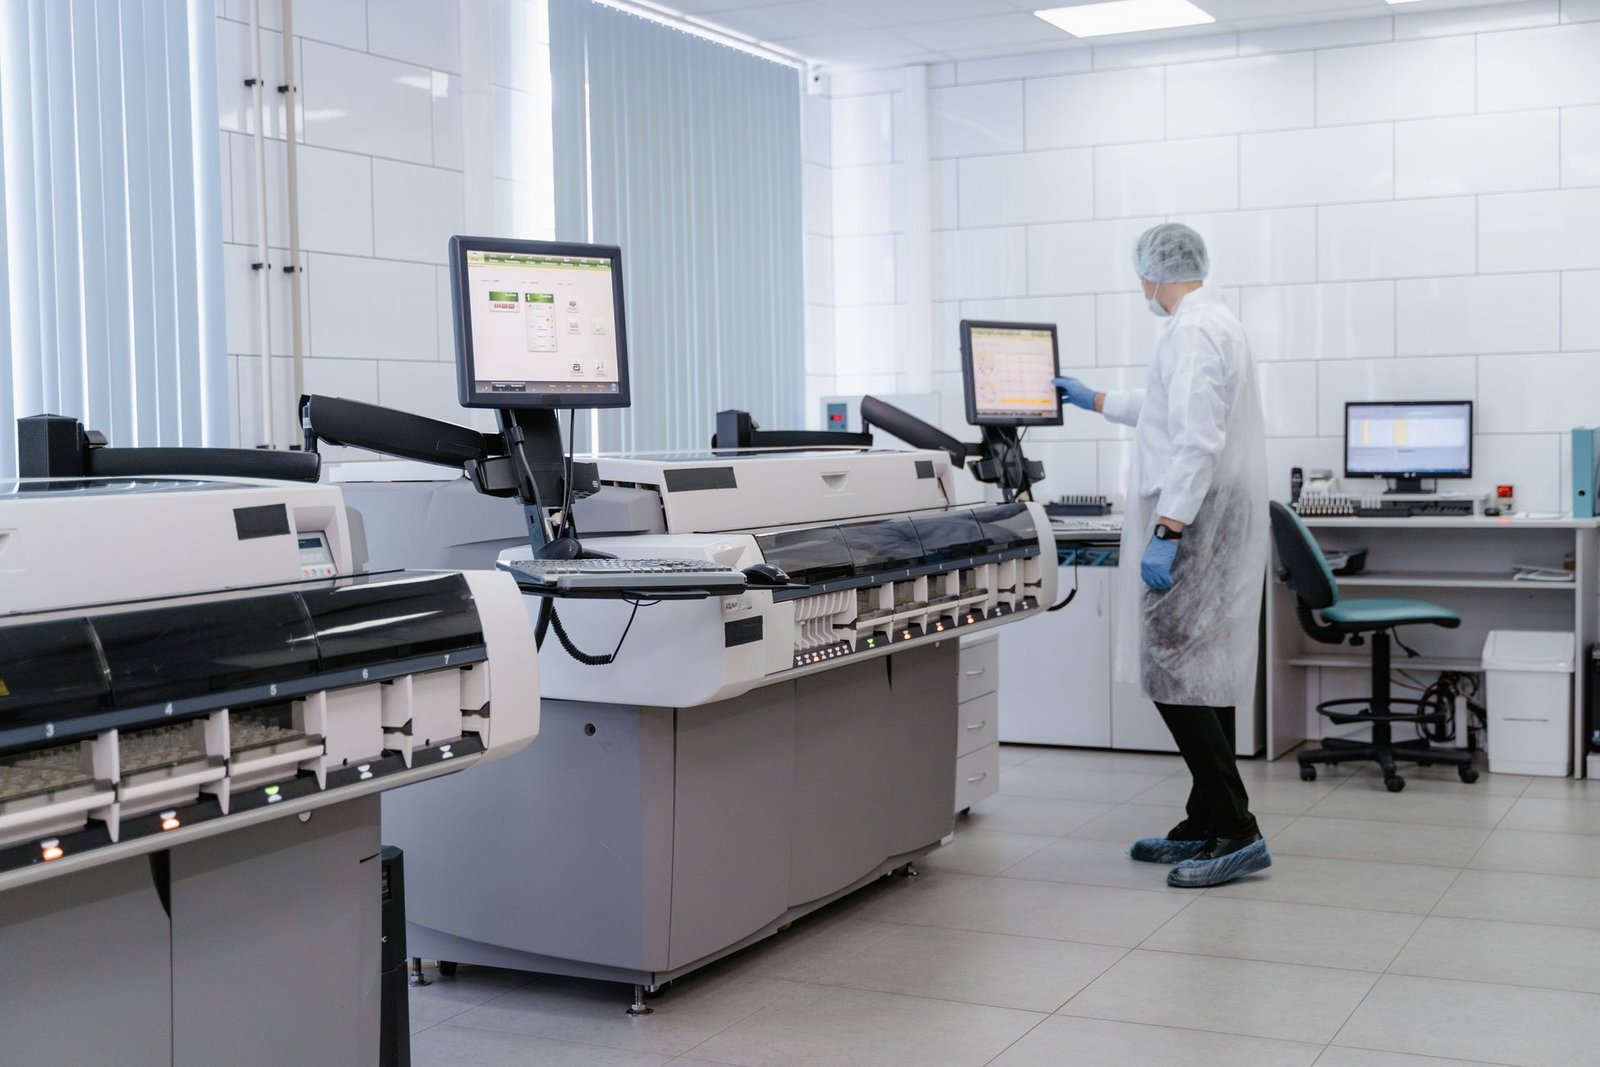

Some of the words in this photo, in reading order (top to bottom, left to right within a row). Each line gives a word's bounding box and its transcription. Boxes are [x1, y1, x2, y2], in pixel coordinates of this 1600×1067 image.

[45, 723, 55, 737] 3
[165, 702, 173, 716] 4
[270, 684, 277, 696] 5
[362, 668, 369, 680] 6
[444, 654, 450, 665] 7
